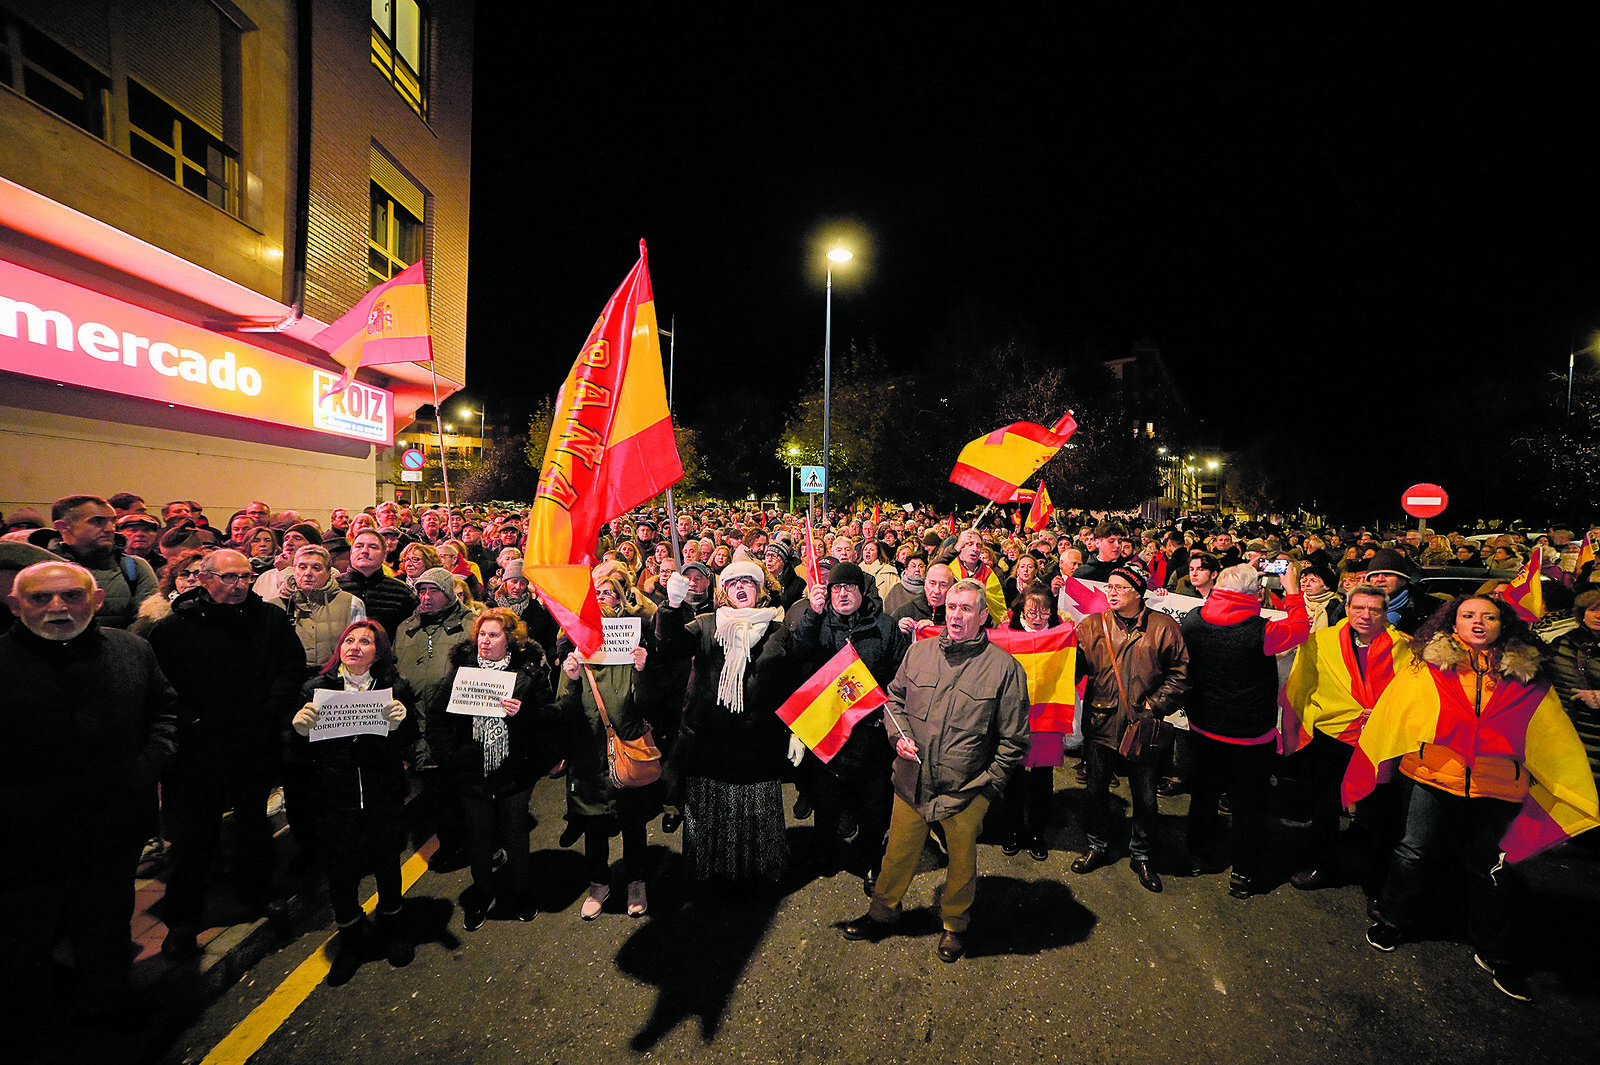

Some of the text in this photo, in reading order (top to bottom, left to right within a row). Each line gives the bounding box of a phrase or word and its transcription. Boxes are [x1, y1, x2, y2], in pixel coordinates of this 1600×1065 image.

[0, 295, 262, 396] mercado
[318, 375, 383, 424] FROIZ
[313, 722, 351, 730] CORRUPTO
